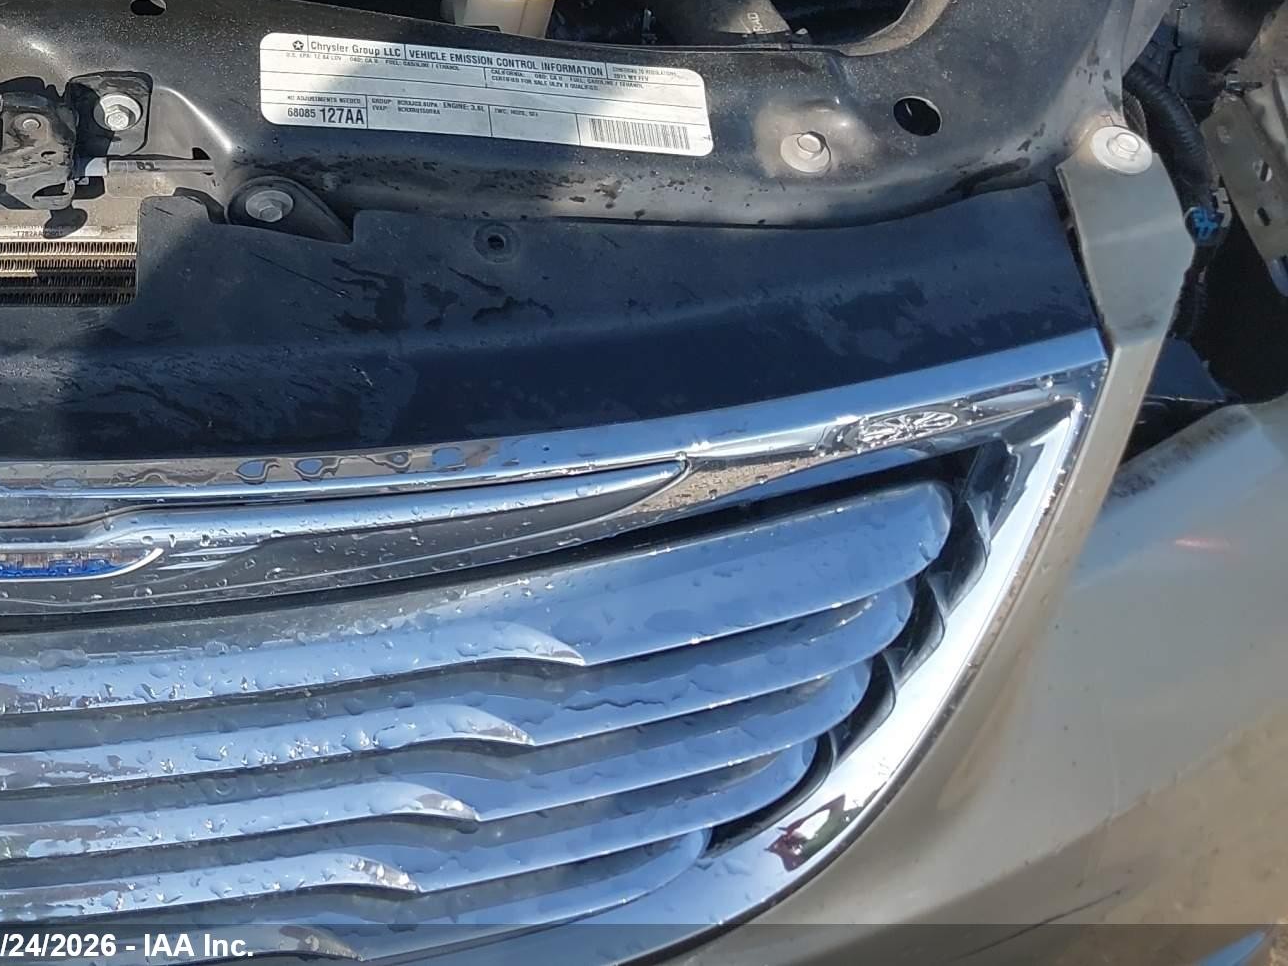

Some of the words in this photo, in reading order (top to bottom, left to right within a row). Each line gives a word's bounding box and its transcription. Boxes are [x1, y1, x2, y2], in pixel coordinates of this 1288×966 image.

[310, 40, 348, 54] Chrysler
[352, 44, 380, 57] Group
[383, 47, 400, 57] LLC
[409, 49, 446, 61] VEHICLE
[450, 53, 494, 65] EMISSION
[496, 57, 537, 69] CONTROL
[541, 61, 603, 76] INFORMATION
[287, 106, 316, 118] 68085
[320, 107, 364, 125] 127AA
